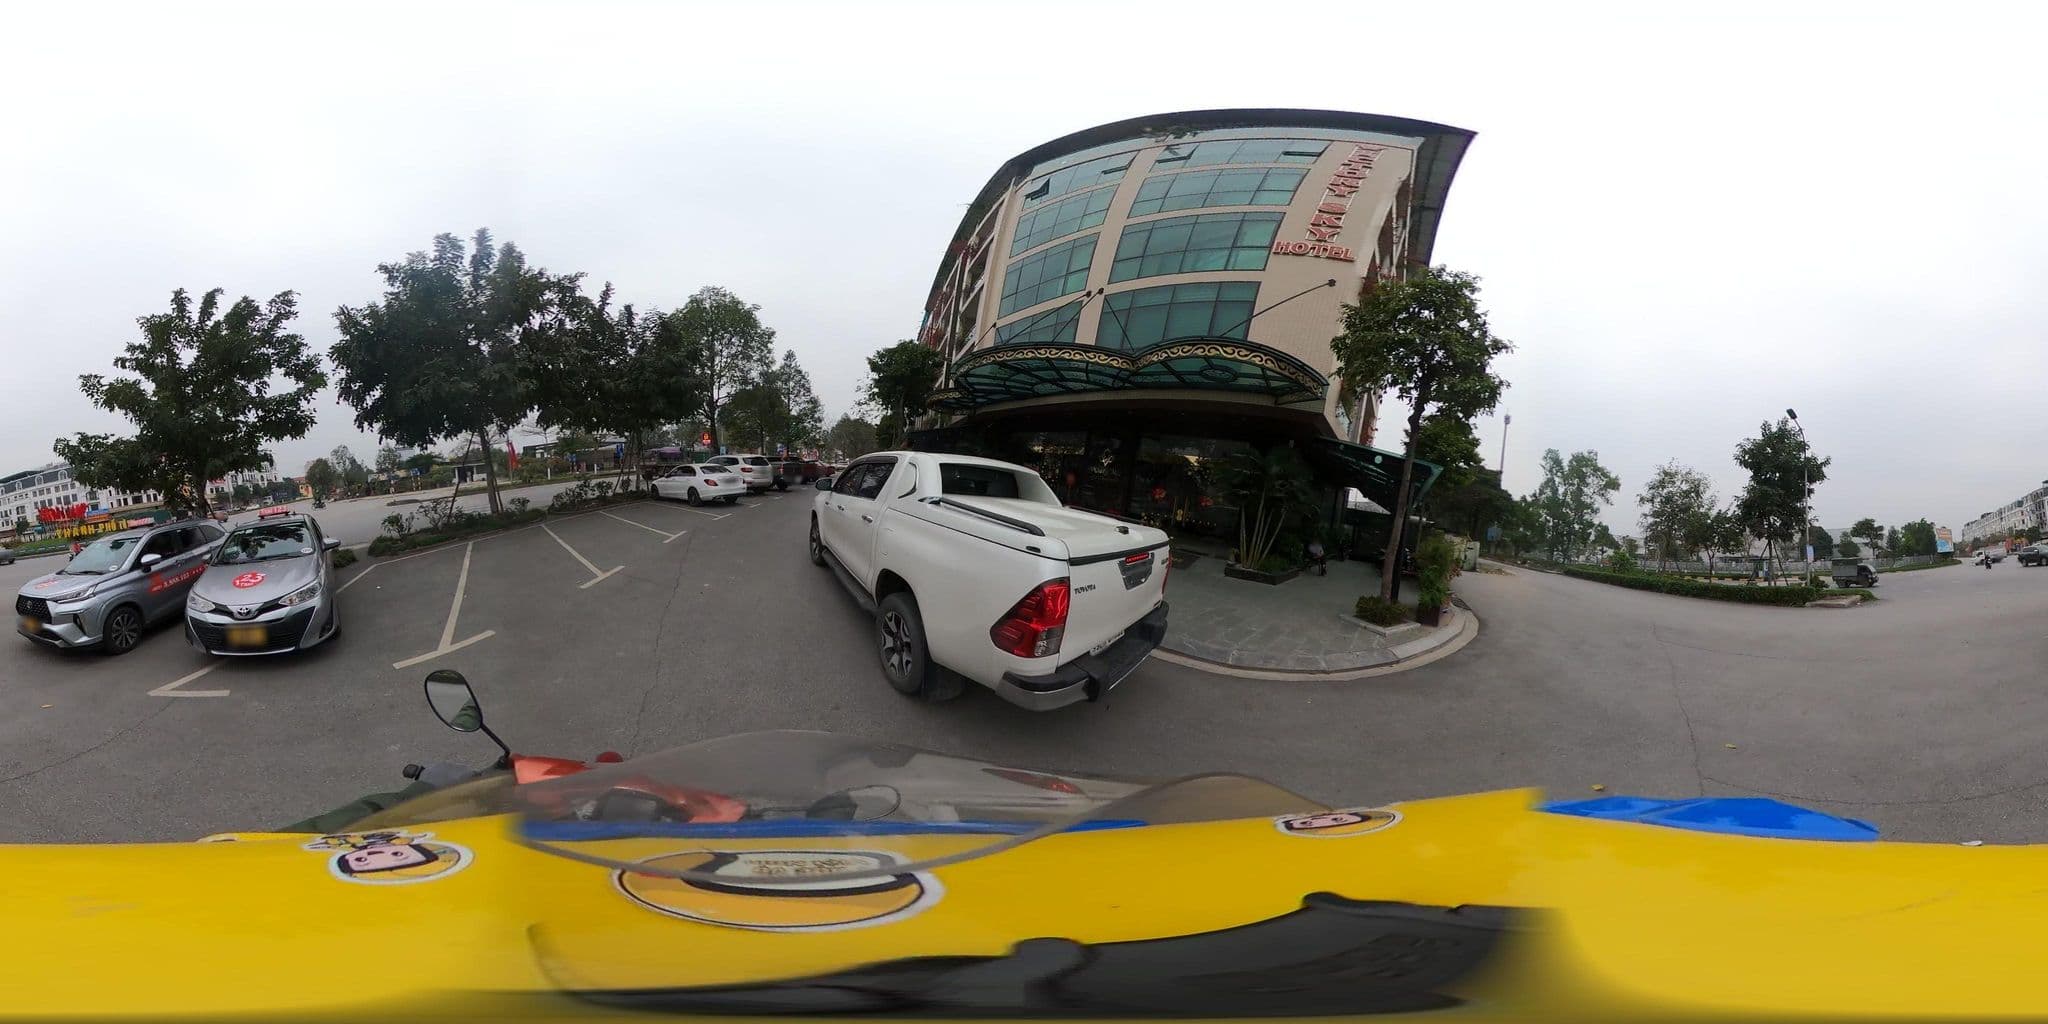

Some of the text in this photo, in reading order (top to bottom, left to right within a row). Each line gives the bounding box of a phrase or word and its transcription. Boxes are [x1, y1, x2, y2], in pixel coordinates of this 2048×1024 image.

[1307, 202, 1347, 242] SKY
[1272, 240, 1356, 263] HOTEL
[1074, 584, 1096, 595] TOYOTA
